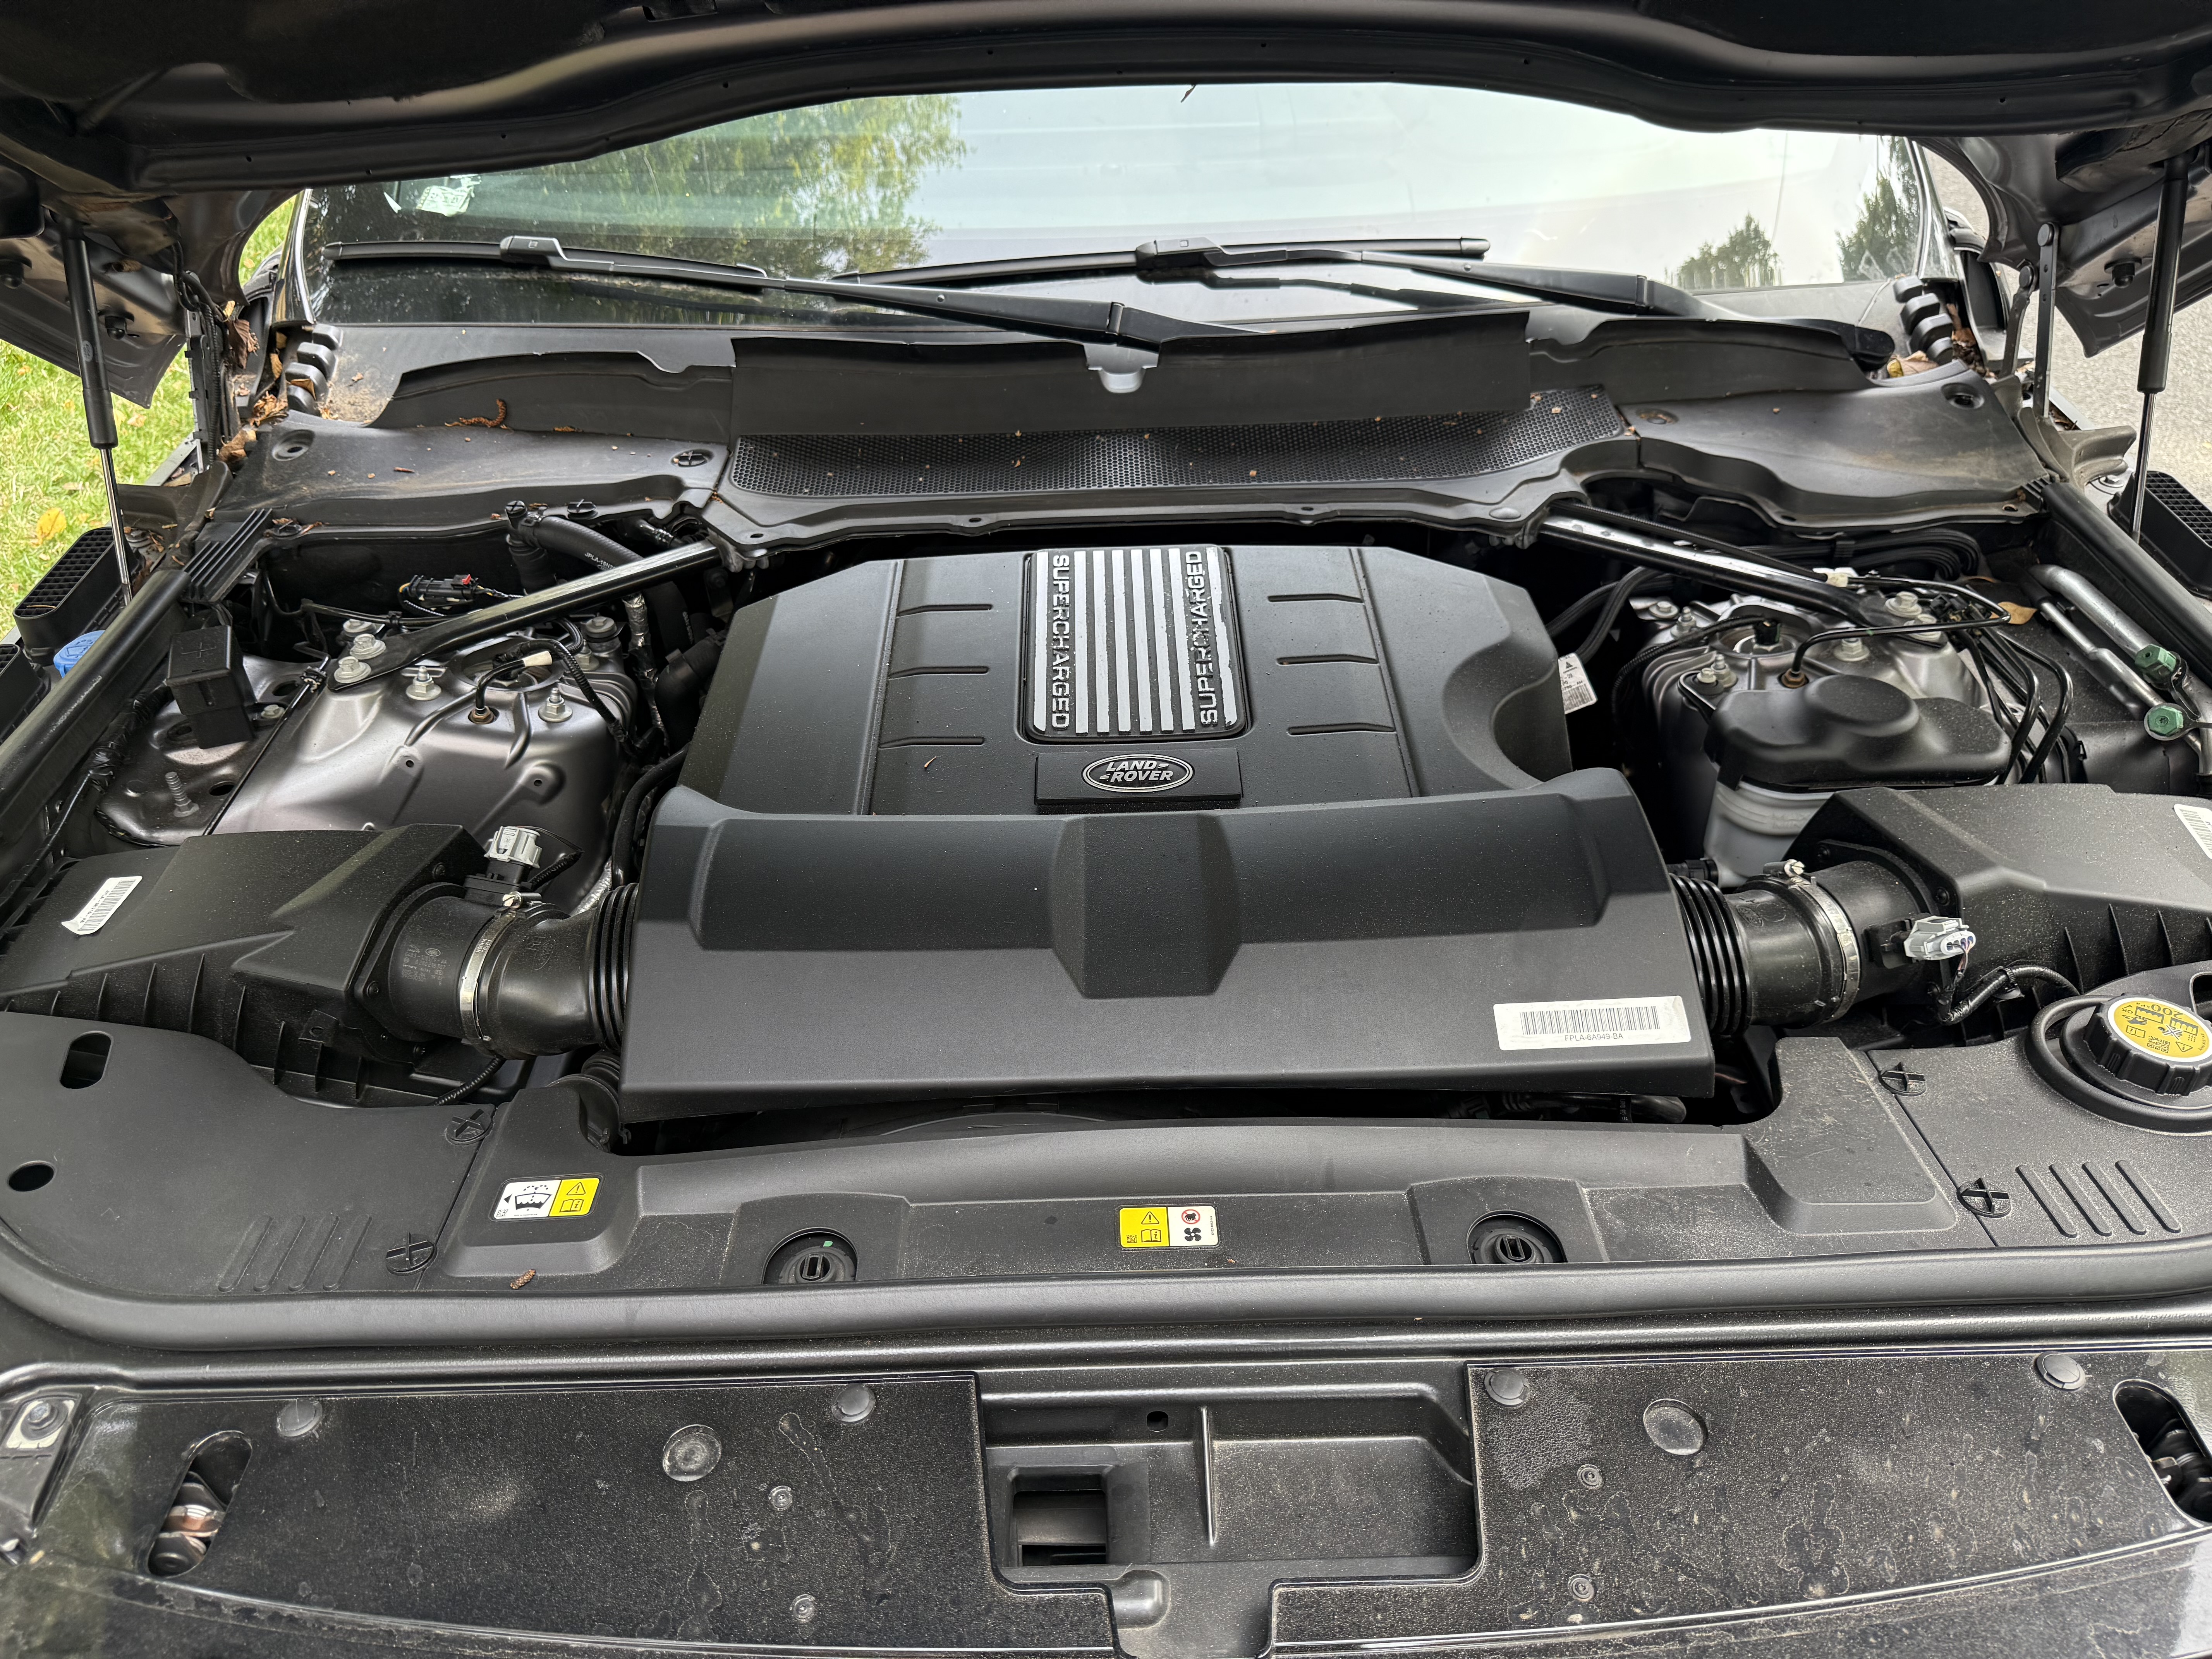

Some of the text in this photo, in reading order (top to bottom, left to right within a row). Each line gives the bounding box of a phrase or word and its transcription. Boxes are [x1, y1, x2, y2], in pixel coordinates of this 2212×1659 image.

[1051, 554, 1070, 731] SUPERCHARGED
[1185, 551, 1218, 727] SUPERCHARGED
[1106, 761, 1157, 772] LAND
[1110, 769, 1173, 782] ROVER
[2151, 1004, 2184, 1020] 200
